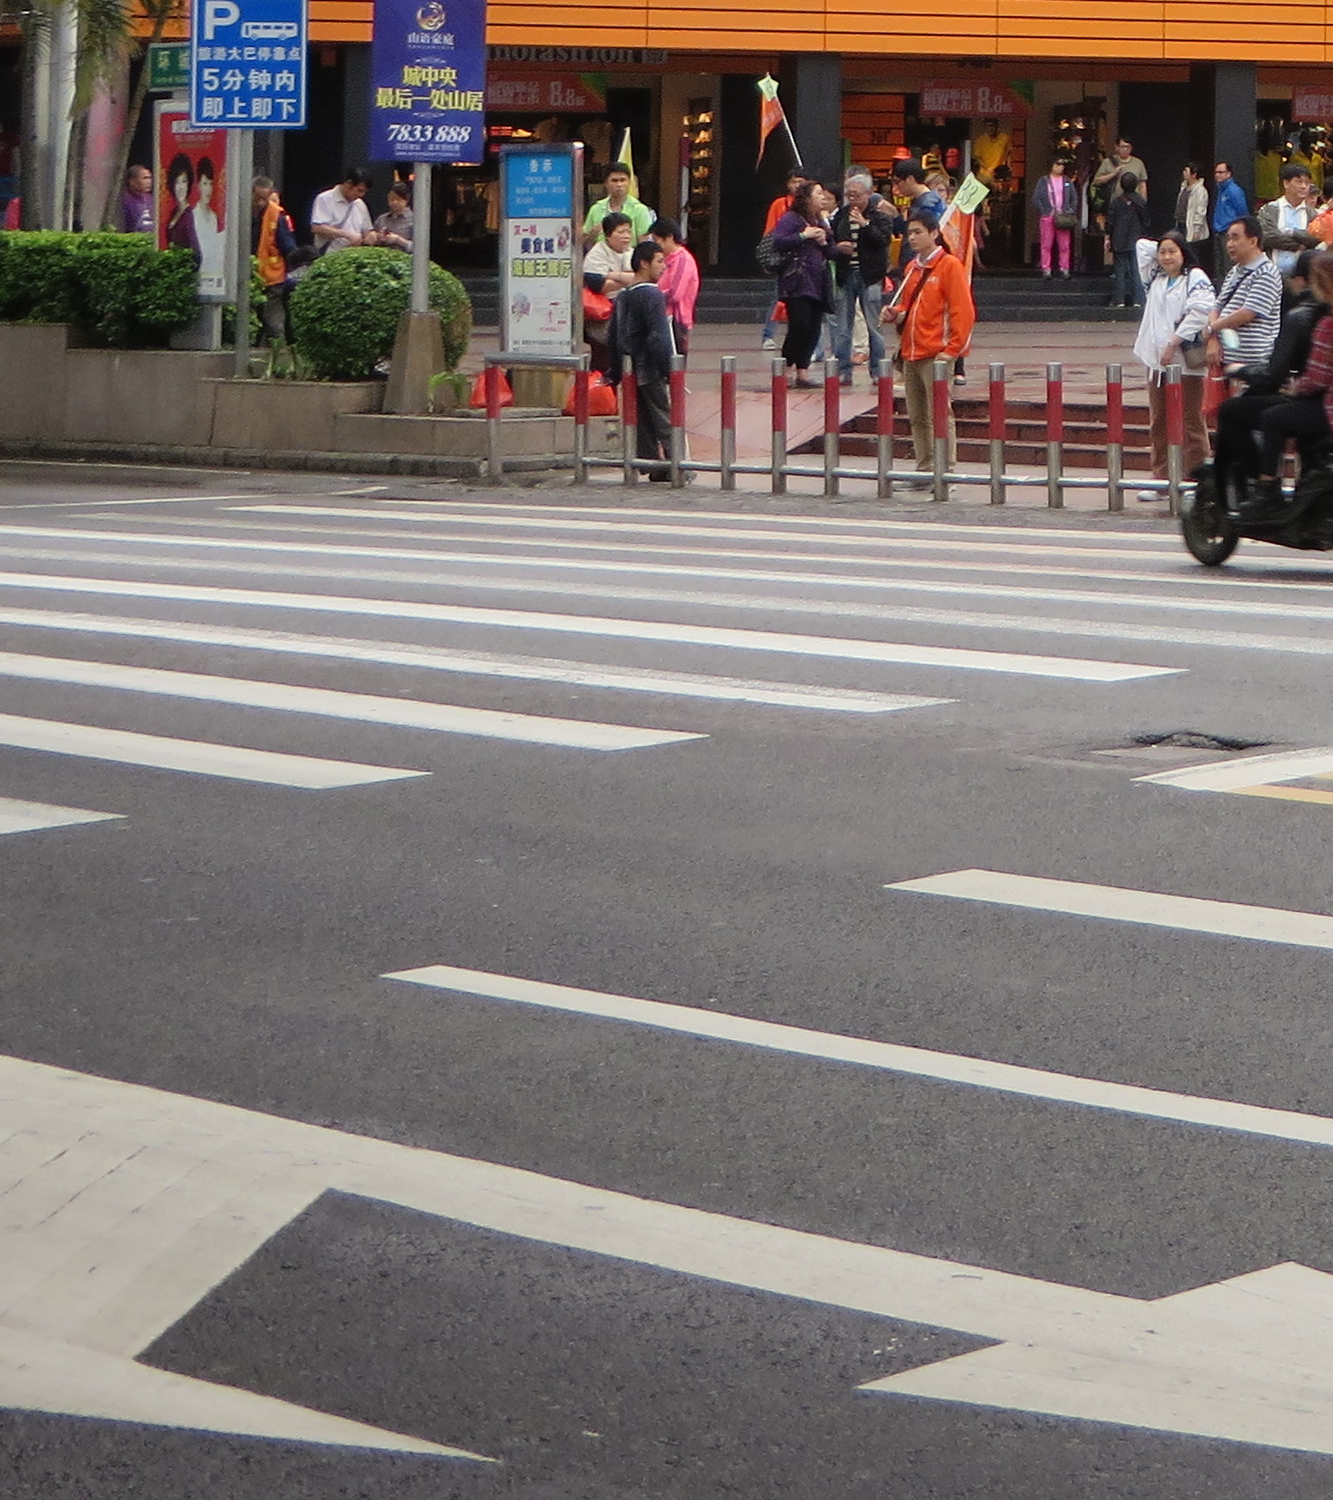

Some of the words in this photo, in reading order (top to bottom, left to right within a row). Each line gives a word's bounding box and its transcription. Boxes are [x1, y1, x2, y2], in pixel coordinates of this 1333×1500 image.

[203, 0, 241, 41] P
[198, 46, 302, 62] 旅游大巴停靠点
[202, 67, 296, 92] 5分钟内
[403, 65, 457, 88] 城中央
[201, 96, 298, 120] 即上即下
[375, 87, 484, 112] 最后一处山居
[387, 124, 434, 143] 7833
[435, 125, 472, 144] 888
